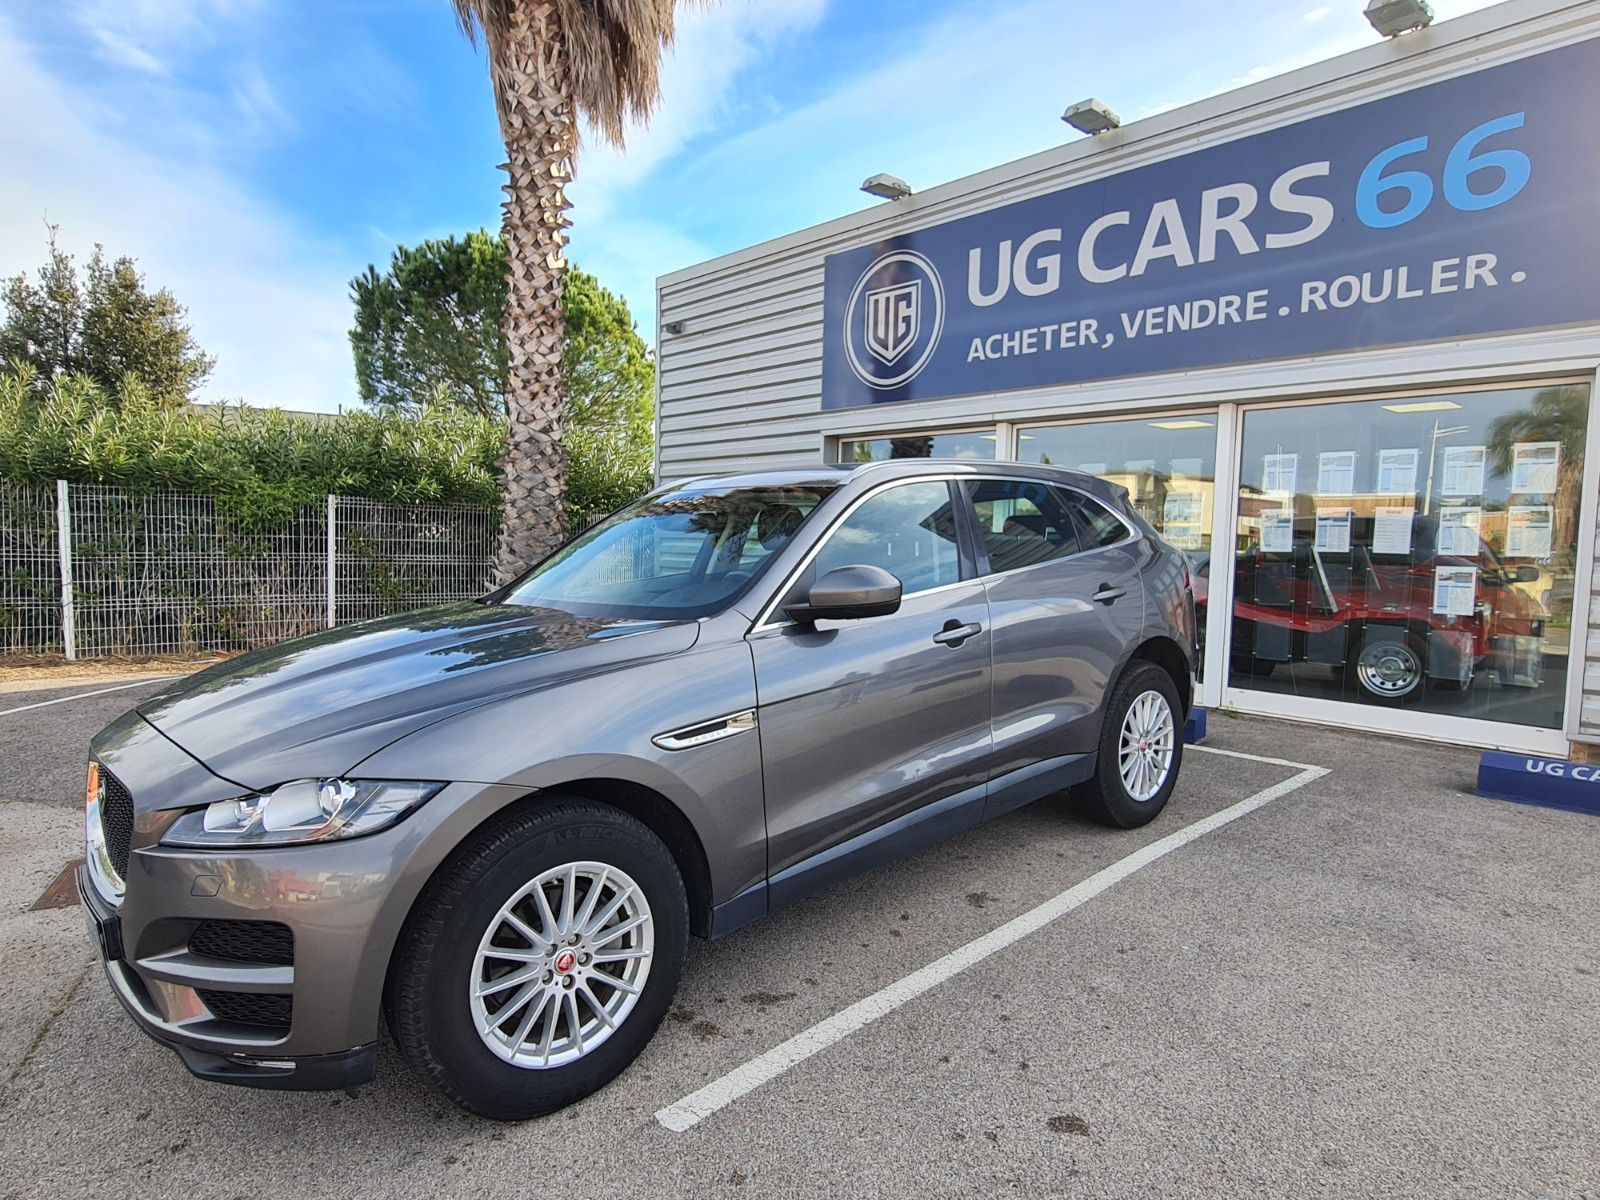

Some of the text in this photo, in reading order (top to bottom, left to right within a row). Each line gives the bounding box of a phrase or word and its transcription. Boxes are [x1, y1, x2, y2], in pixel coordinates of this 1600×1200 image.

[968, 111, 1531, 307] UG CARS 66
[688, 729, 728, 743] JAGUAR
[1525, 759, 1565, 777] UG
